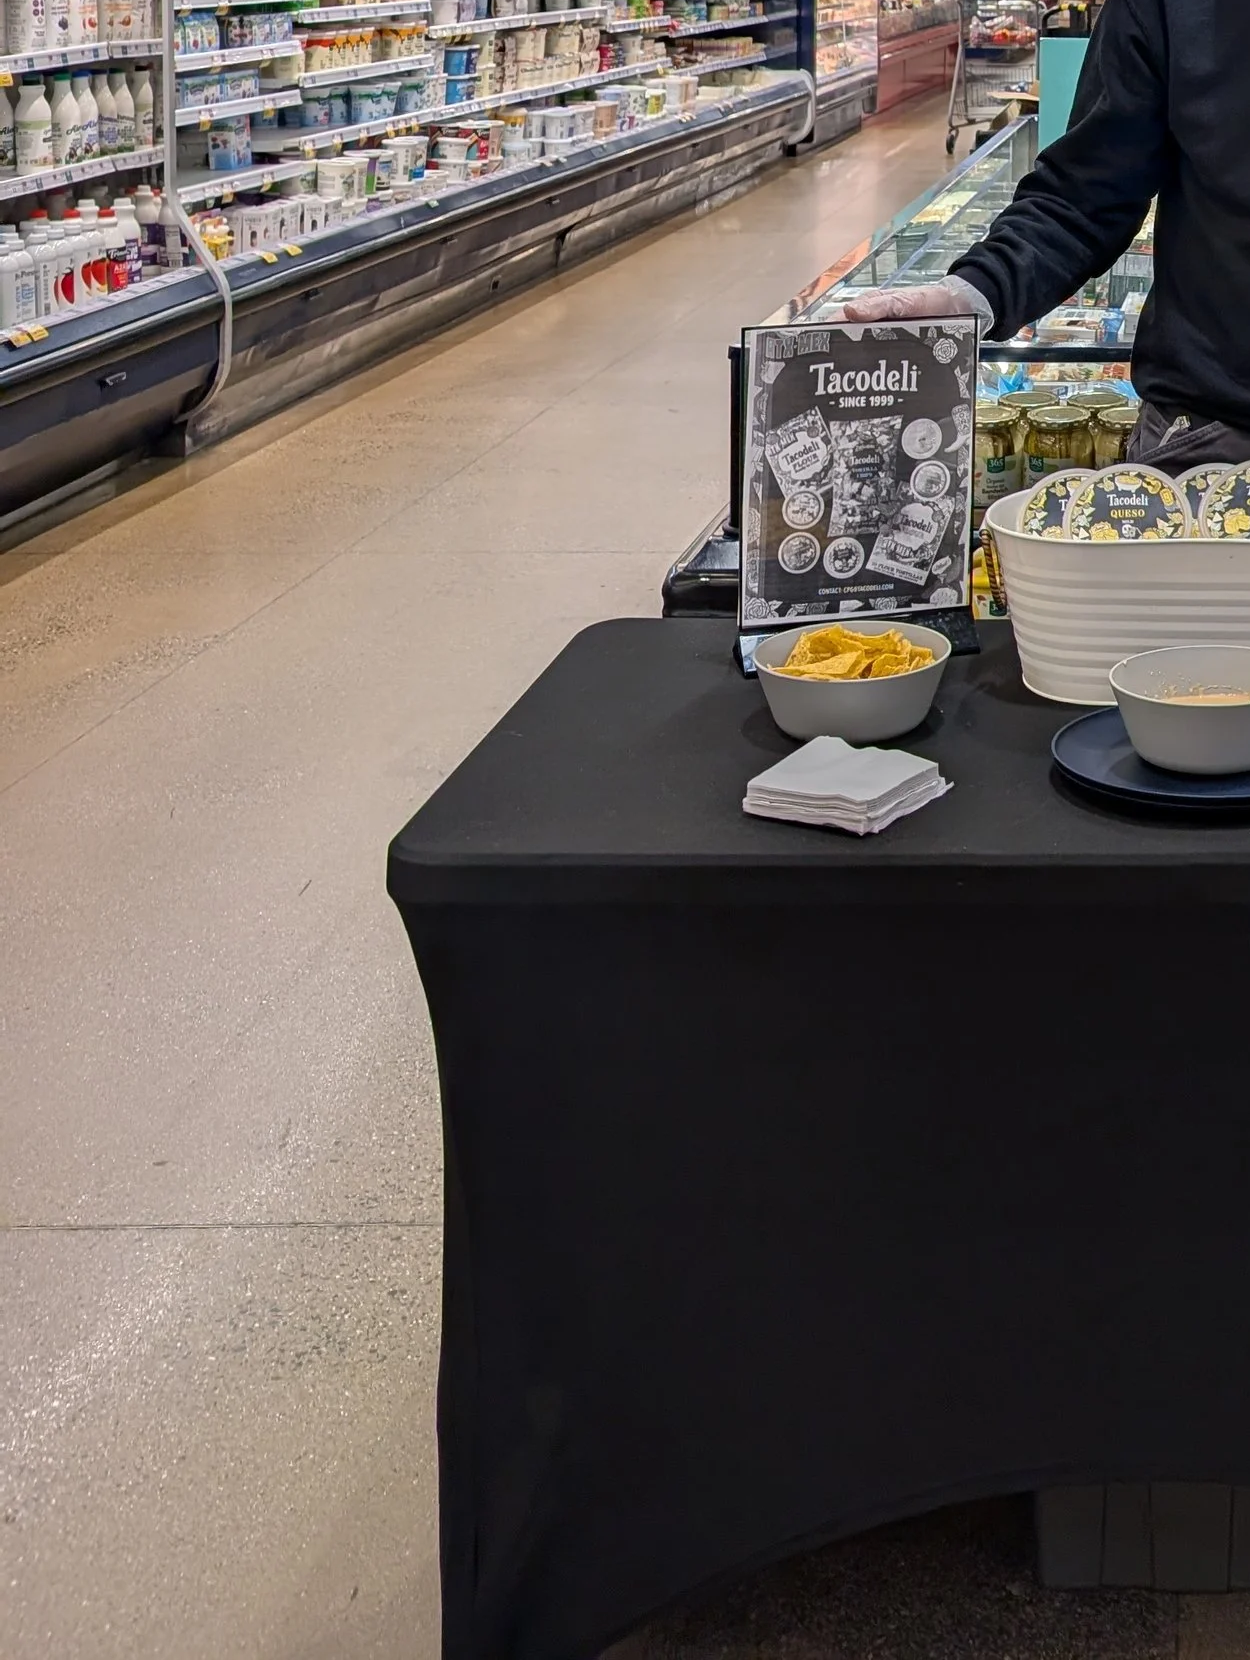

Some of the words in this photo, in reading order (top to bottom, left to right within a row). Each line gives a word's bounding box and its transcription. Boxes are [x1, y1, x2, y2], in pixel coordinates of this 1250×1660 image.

[809, 360, 918, 396] Tacodeli
[838, 396, 866, 408] SINCE
[869, 395, 894, 407] 1999
[782, 441, 820, 465] Tacodeli
[851, 454, 880, 464] Tacodeli
[989, 459, 1004, 468] 365
[1031, 458, 1042, 467] 365
[1107, 493, 1149, 507] Tacodeli
[1110, 509, 1145, 518] QUESO
